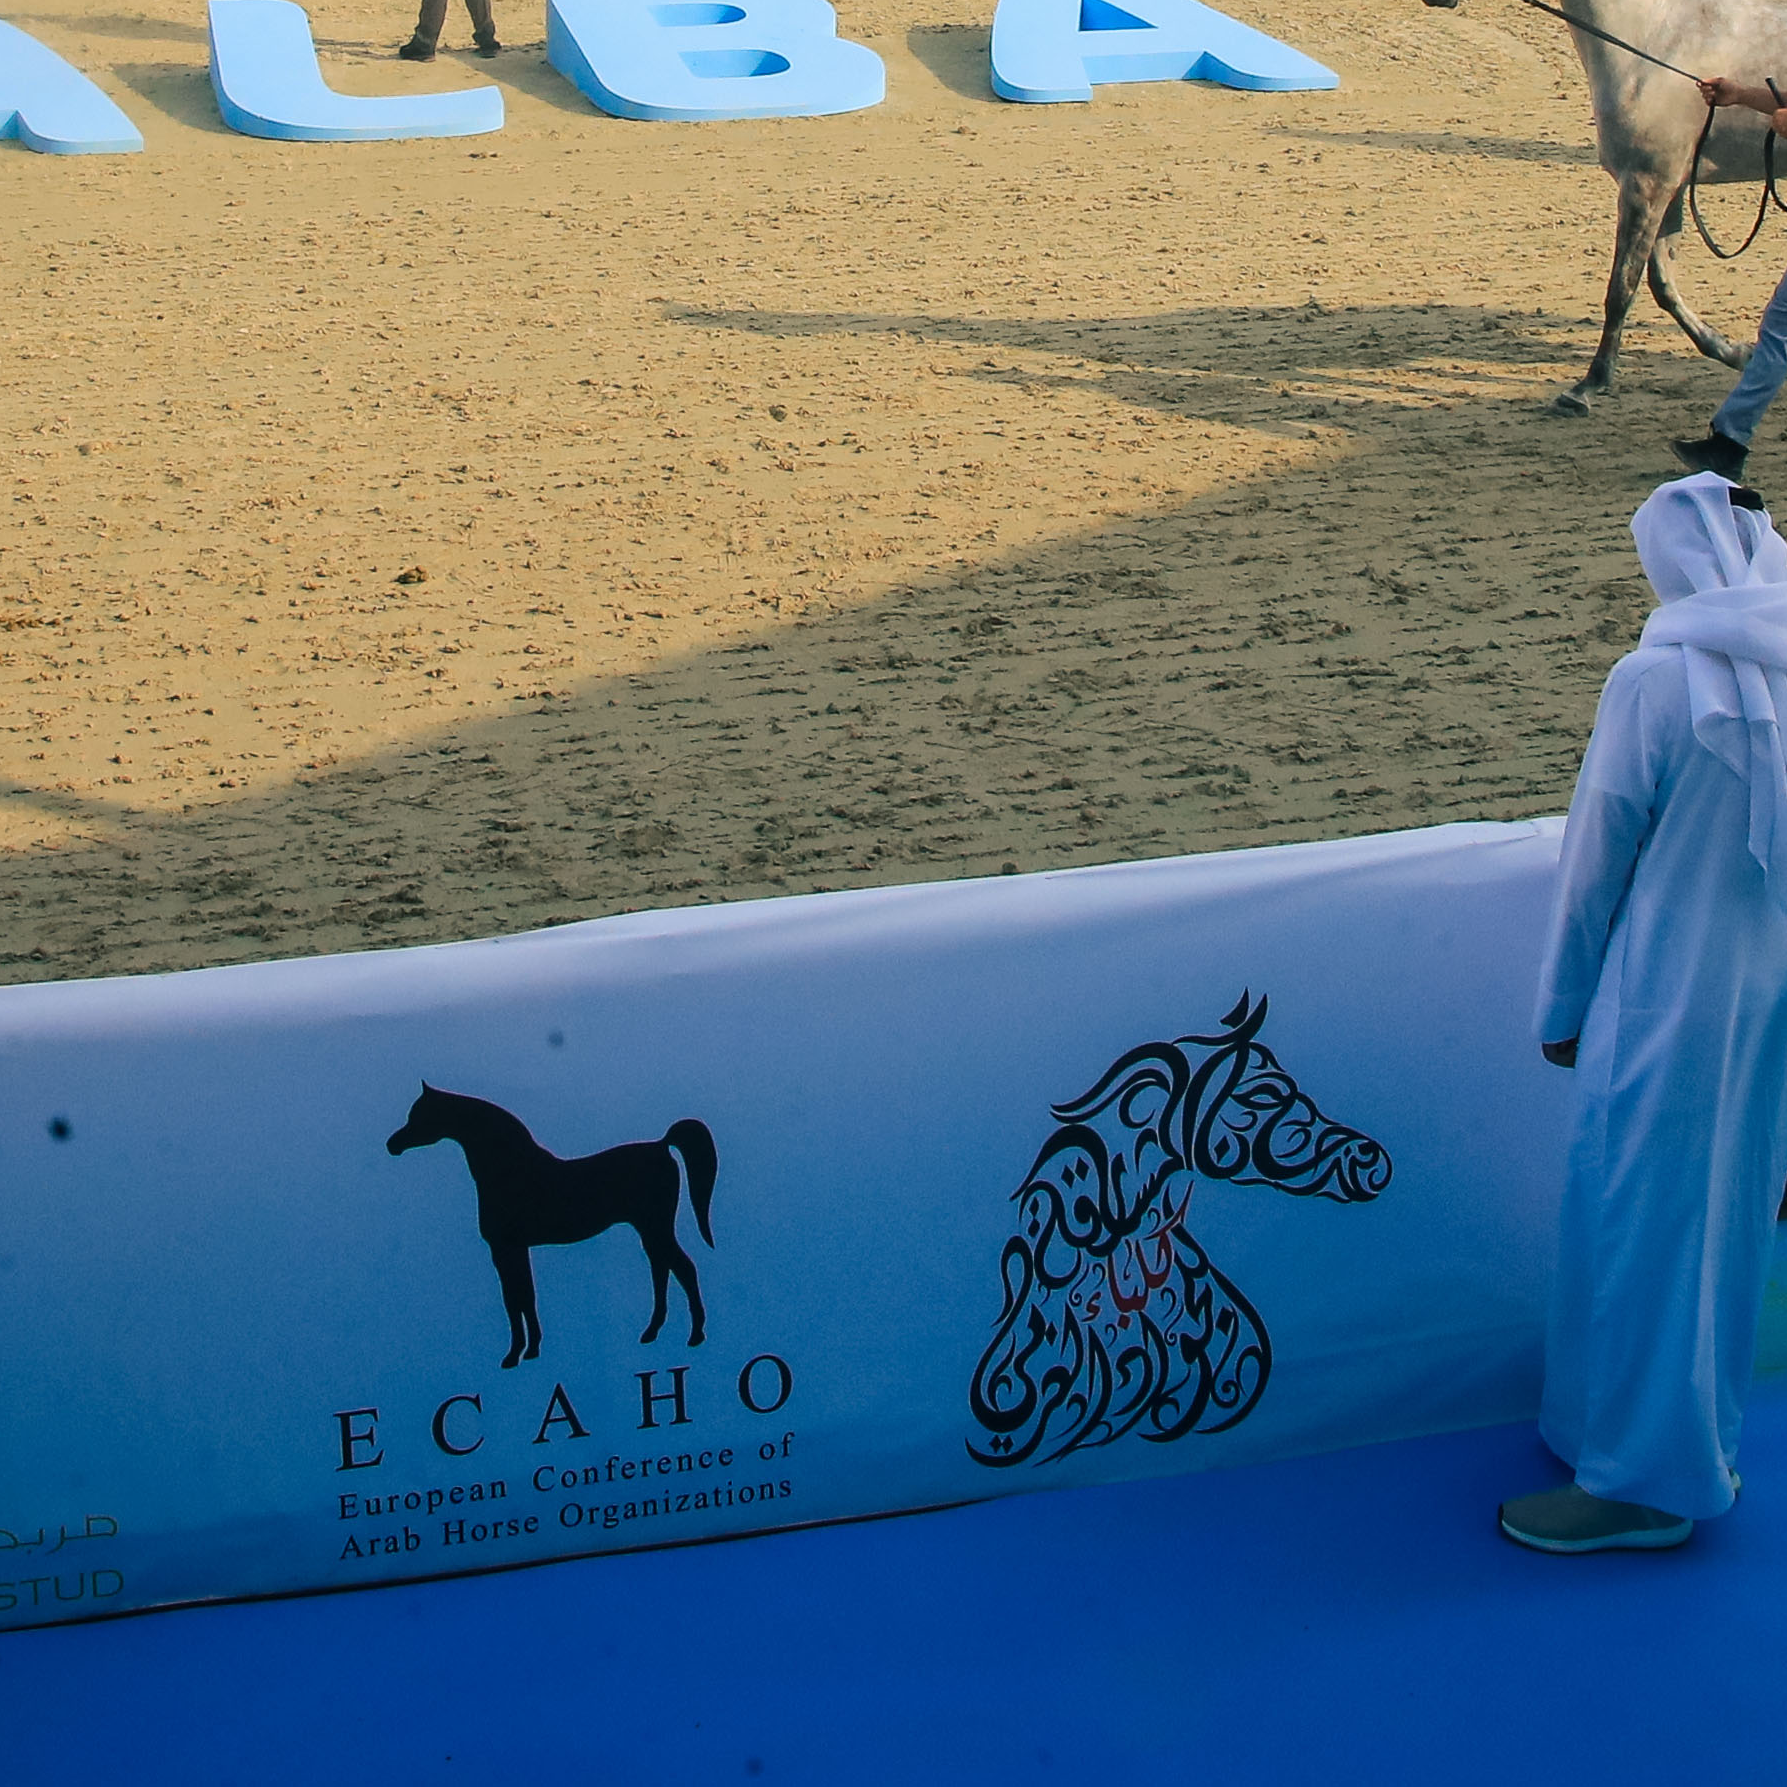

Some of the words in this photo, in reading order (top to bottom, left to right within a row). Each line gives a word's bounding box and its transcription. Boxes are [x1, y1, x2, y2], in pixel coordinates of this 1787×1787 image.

[332, 1353, 794, 1472] ECAHO
[338, 1478, 508, 1520] European
[532, 1446, 734, 1493] Conference
[759, 1431, 796, 1461] of
[339, 1526, 422, 1560] Arab
[442, 1513, 540, 1547] Horse
[558, 1477, 793, 1529] Organizations
